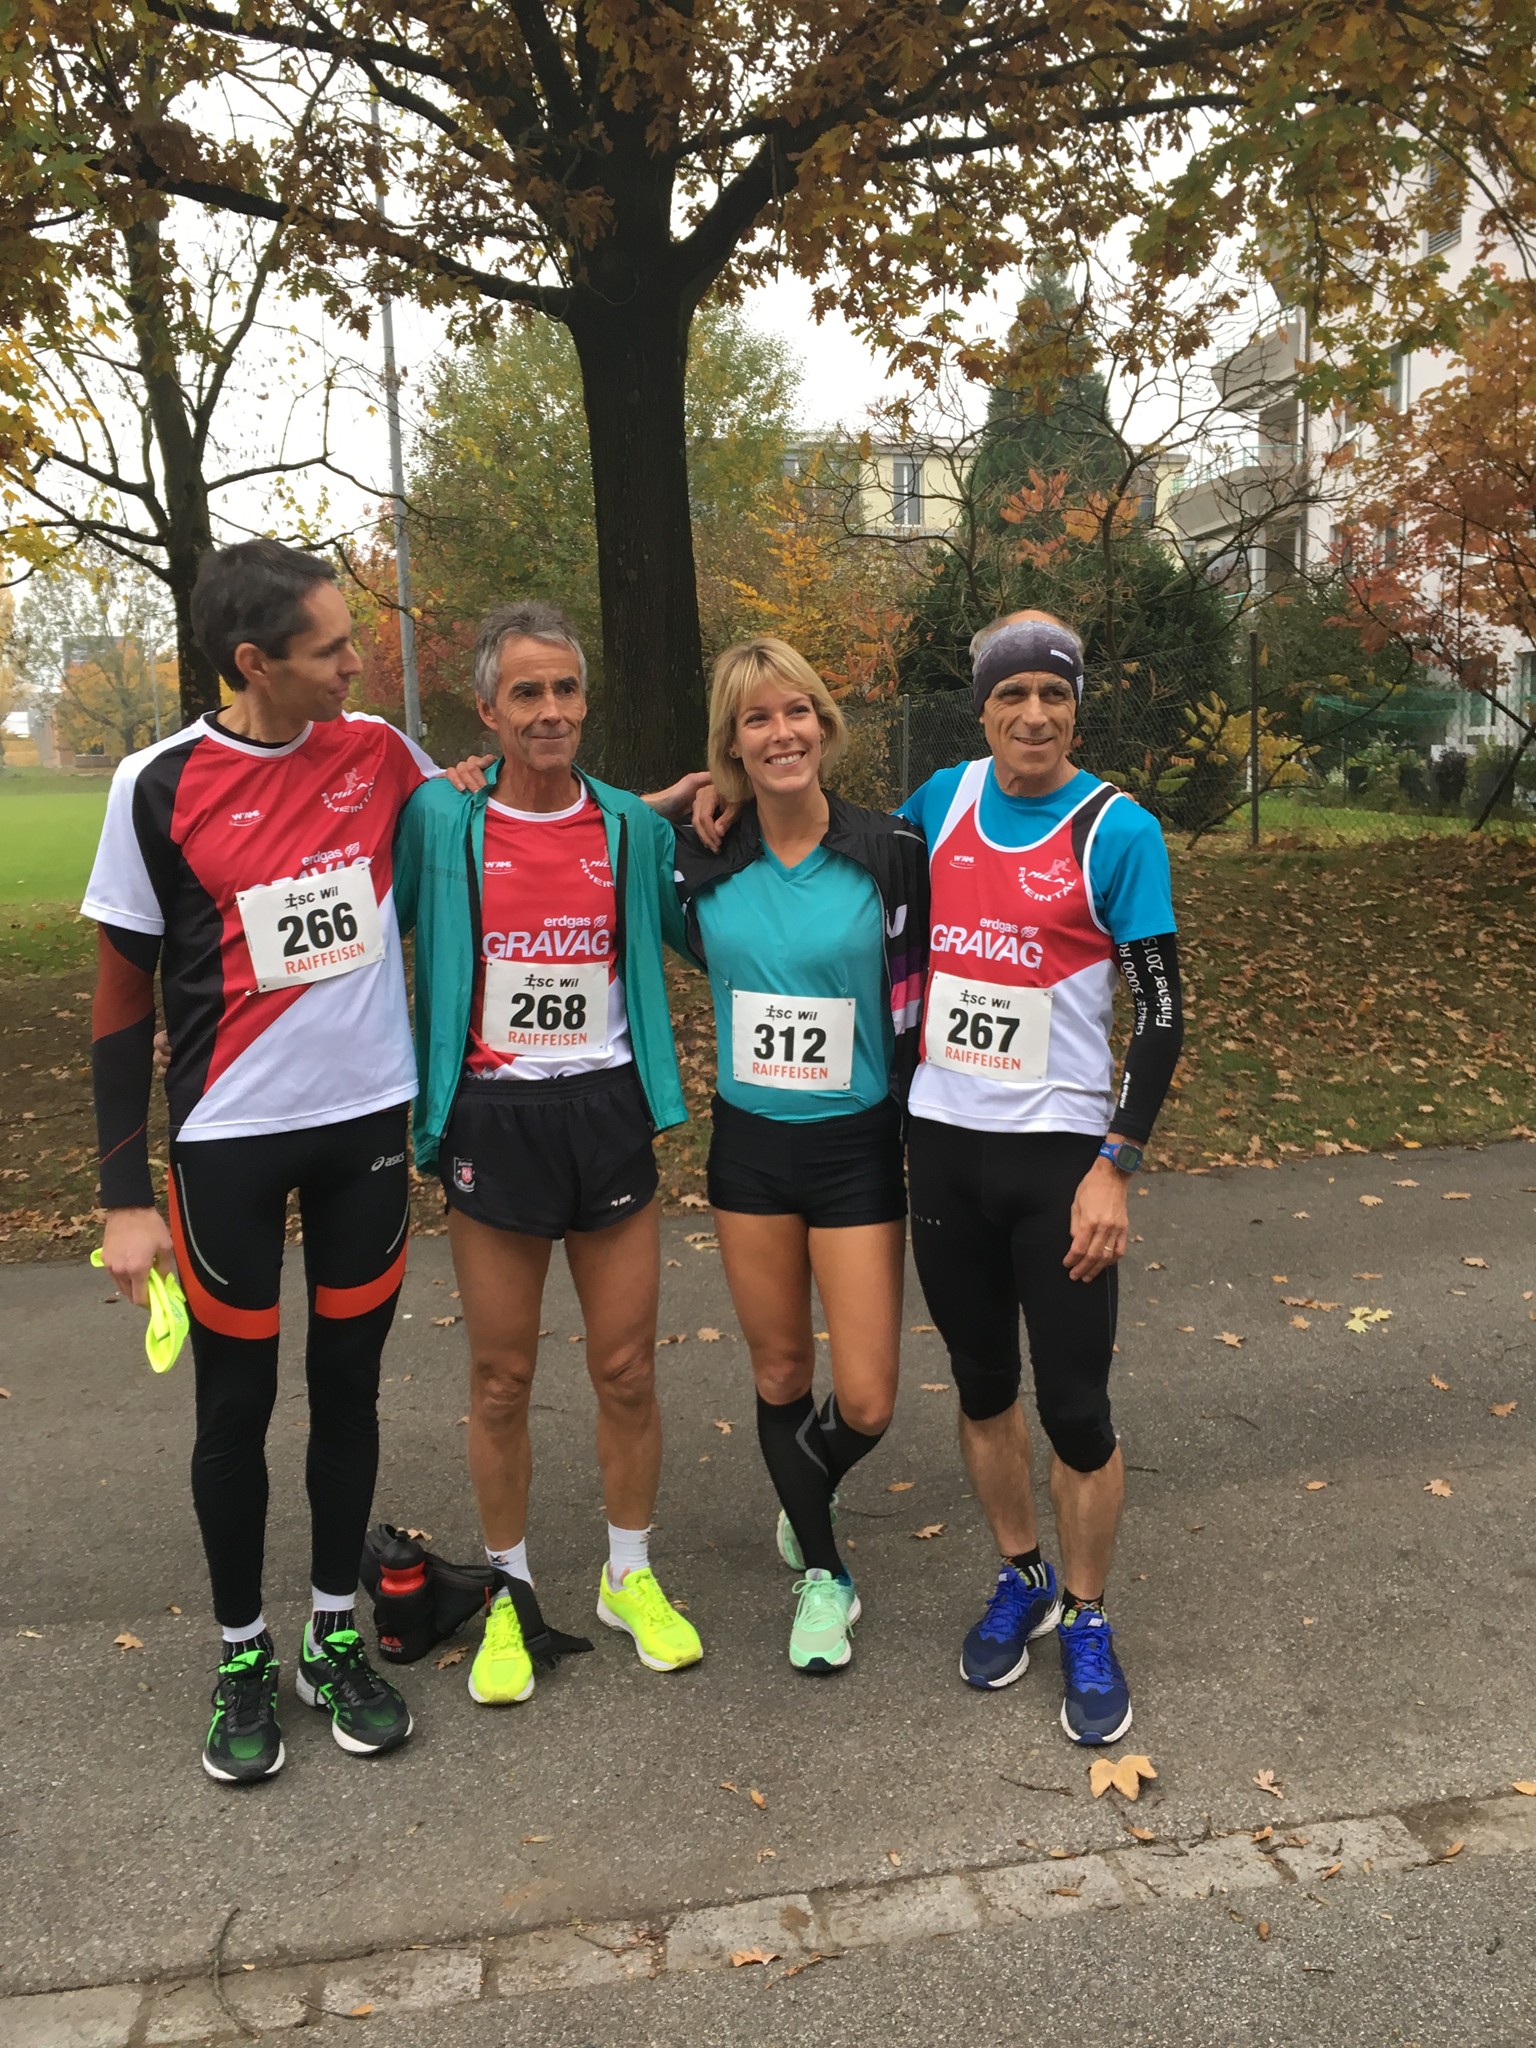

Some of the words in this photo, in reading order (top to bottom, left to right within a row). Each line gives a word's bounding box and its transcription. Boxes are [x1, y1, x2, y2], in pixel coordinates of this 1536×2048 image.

[302, 848, 342, 866] erdgas
[589, 860, 610, 868] MIL
[319, 886, 339, 900] Wil
[1018, 867, 1077, 902] RHEINTAL
[277, 902, 358, 957] 266
[543, 915, 591, 929] erdgas
[979, 917, 1018, 935] erdgas
[482, 929, 610, 959] GRAVAG
[930, 923, 1044, 969] GRAVAG
[1141, 937, 1165, 973] 2015
[285, 942, 366, 975] RAIFFEISEN
[559, 977, 580, 988] Wil
[1122, 961, 1144, 994] 3000
[509, 992, 587, 1031] 268
[797, 1010, 818, 1021] Wil
[991, 997, 1011, 1010] Wil
[1154, 976, 1173, 1028] Finisher
[508, 1031, 587, 1046] RAIFFEISEN
[753, 1023, 827, 1064] 312
[946, 1007, 1021, 1053] 267
[752, 1062, 828, 1080] RAIFFEISEN
[945, 1046, 1022, 1070] RAIFFEISEN
